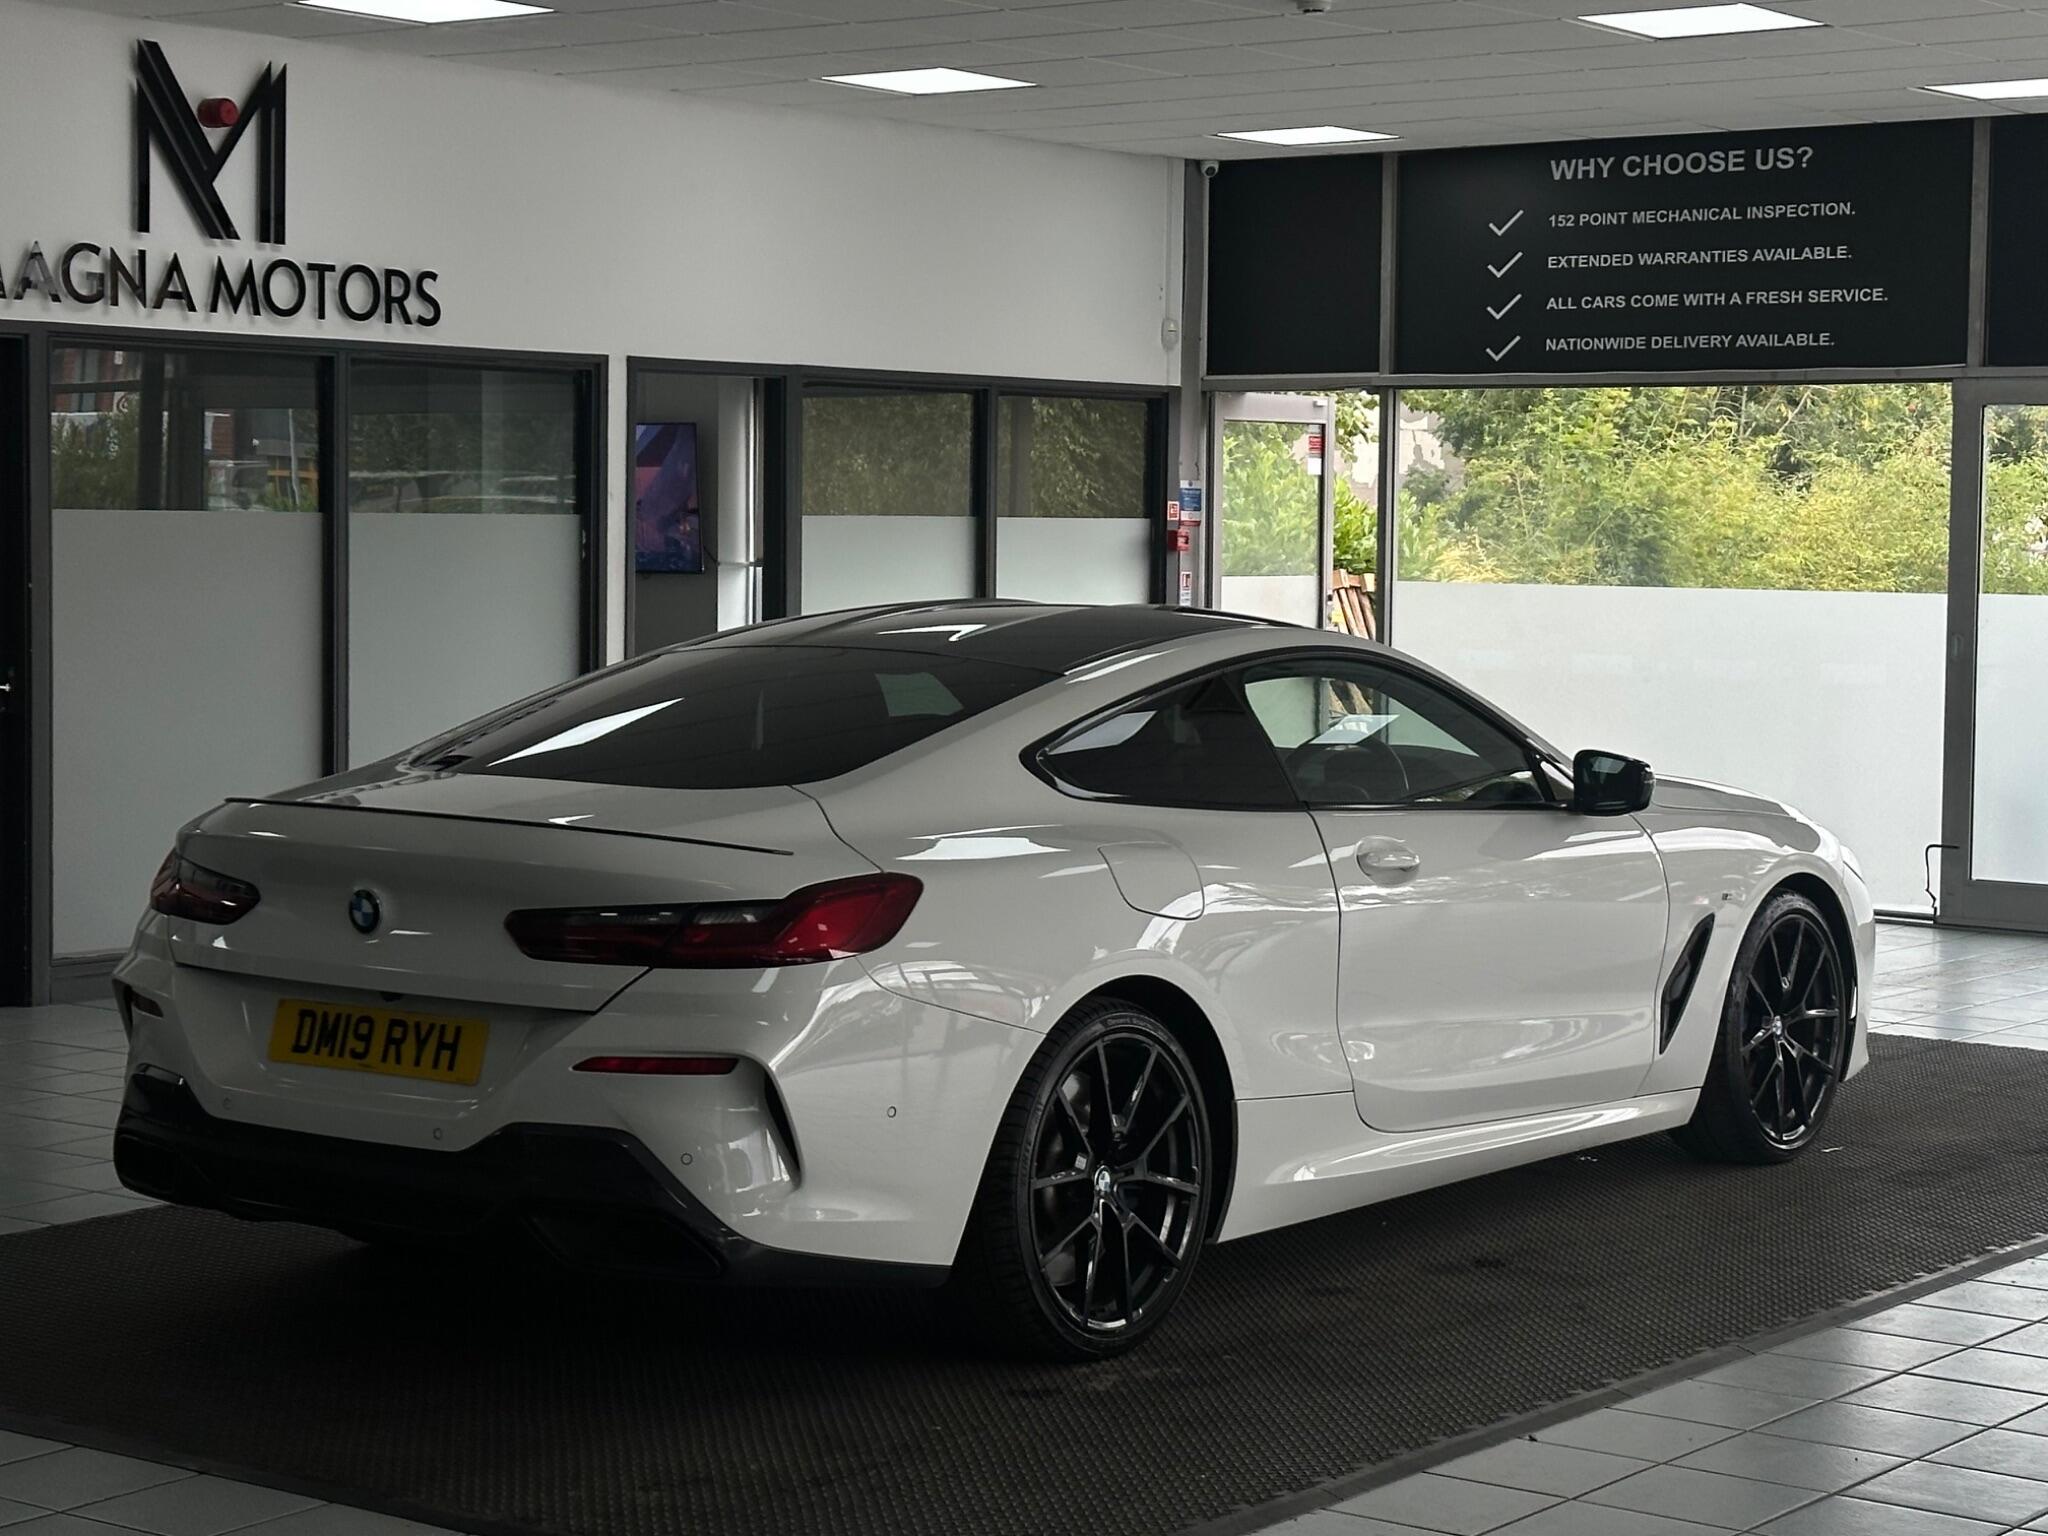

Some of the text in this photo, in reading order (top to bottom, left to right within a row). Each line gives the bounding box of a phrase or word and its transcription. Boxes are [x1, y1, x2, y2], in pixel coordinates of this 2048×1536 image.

[1550, 146, 1813, 181] WHY CHOOSE US?
[1548, 201, 1854, 228] 152 POINT MECHANICAL INSPECTION.
[1547, 245, 1852, 269] EXTENDED WARRANTIES AVAILABLE.
[0, 240, 442, 327] AGNA MOTORS
[1546, 287, 1889, 311] ALL CARS COME WITH A FRESH SERVICE.
[1545, 332, 1835, 352] NATIONWIDE DELIVERY AVAILABLE.
[291, 1008, 463, 1072] DM19 RYH
